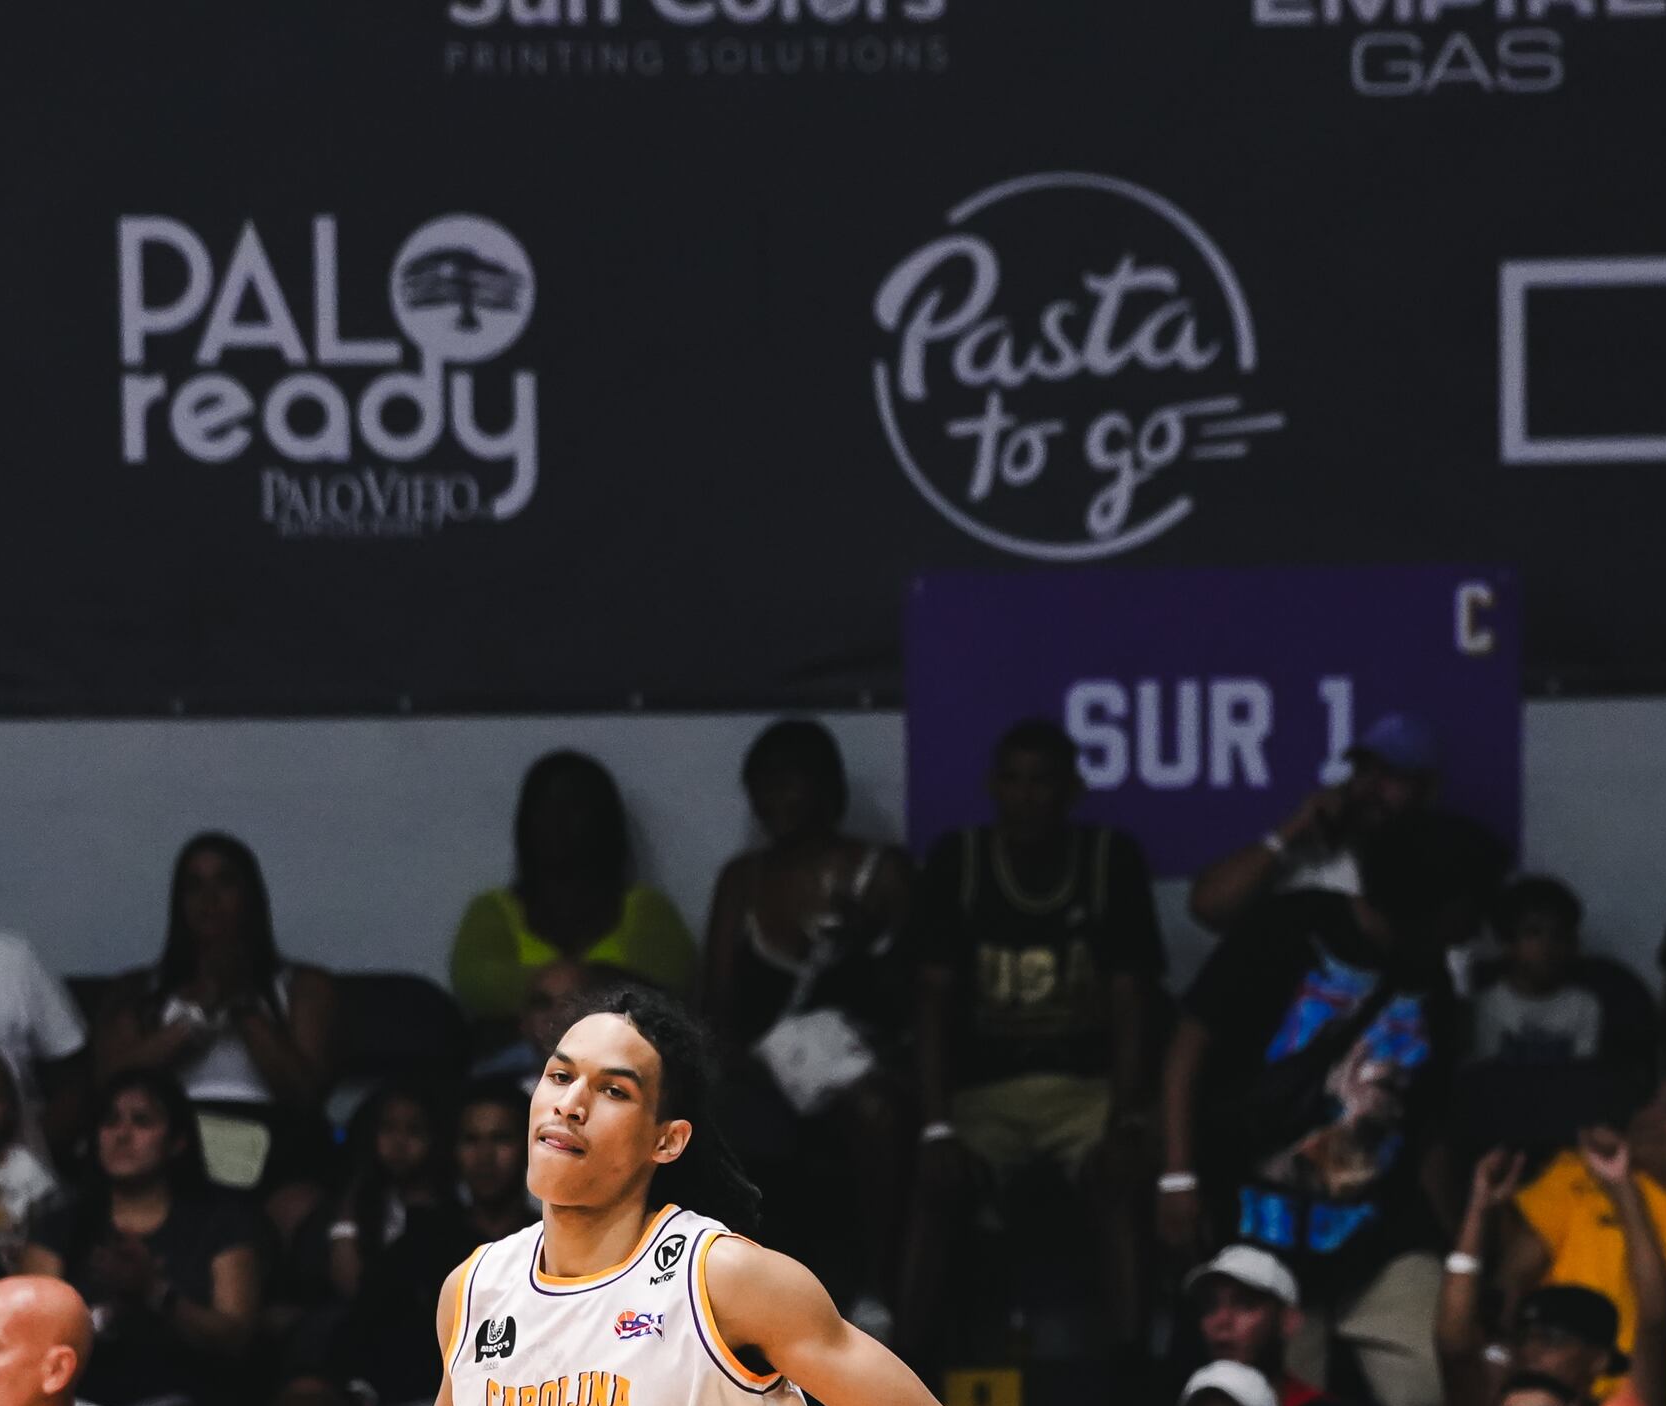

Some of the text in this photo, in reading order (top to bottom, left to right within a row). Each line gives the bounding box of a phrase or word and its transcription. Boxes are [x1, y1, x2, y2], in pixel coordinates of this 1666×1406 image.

[444, 36, 950, 76] PRINTING SOLUTIONS
[1351, 28, 1564, 95] GAS
[873, 233, 1221, 399] Pasta
[121, 366, 537, 520] ready
[946, 391, 1213, 537] to go
[1455, 582, 1494, 654] C
[1065, 679, 1274, 788] SUR
